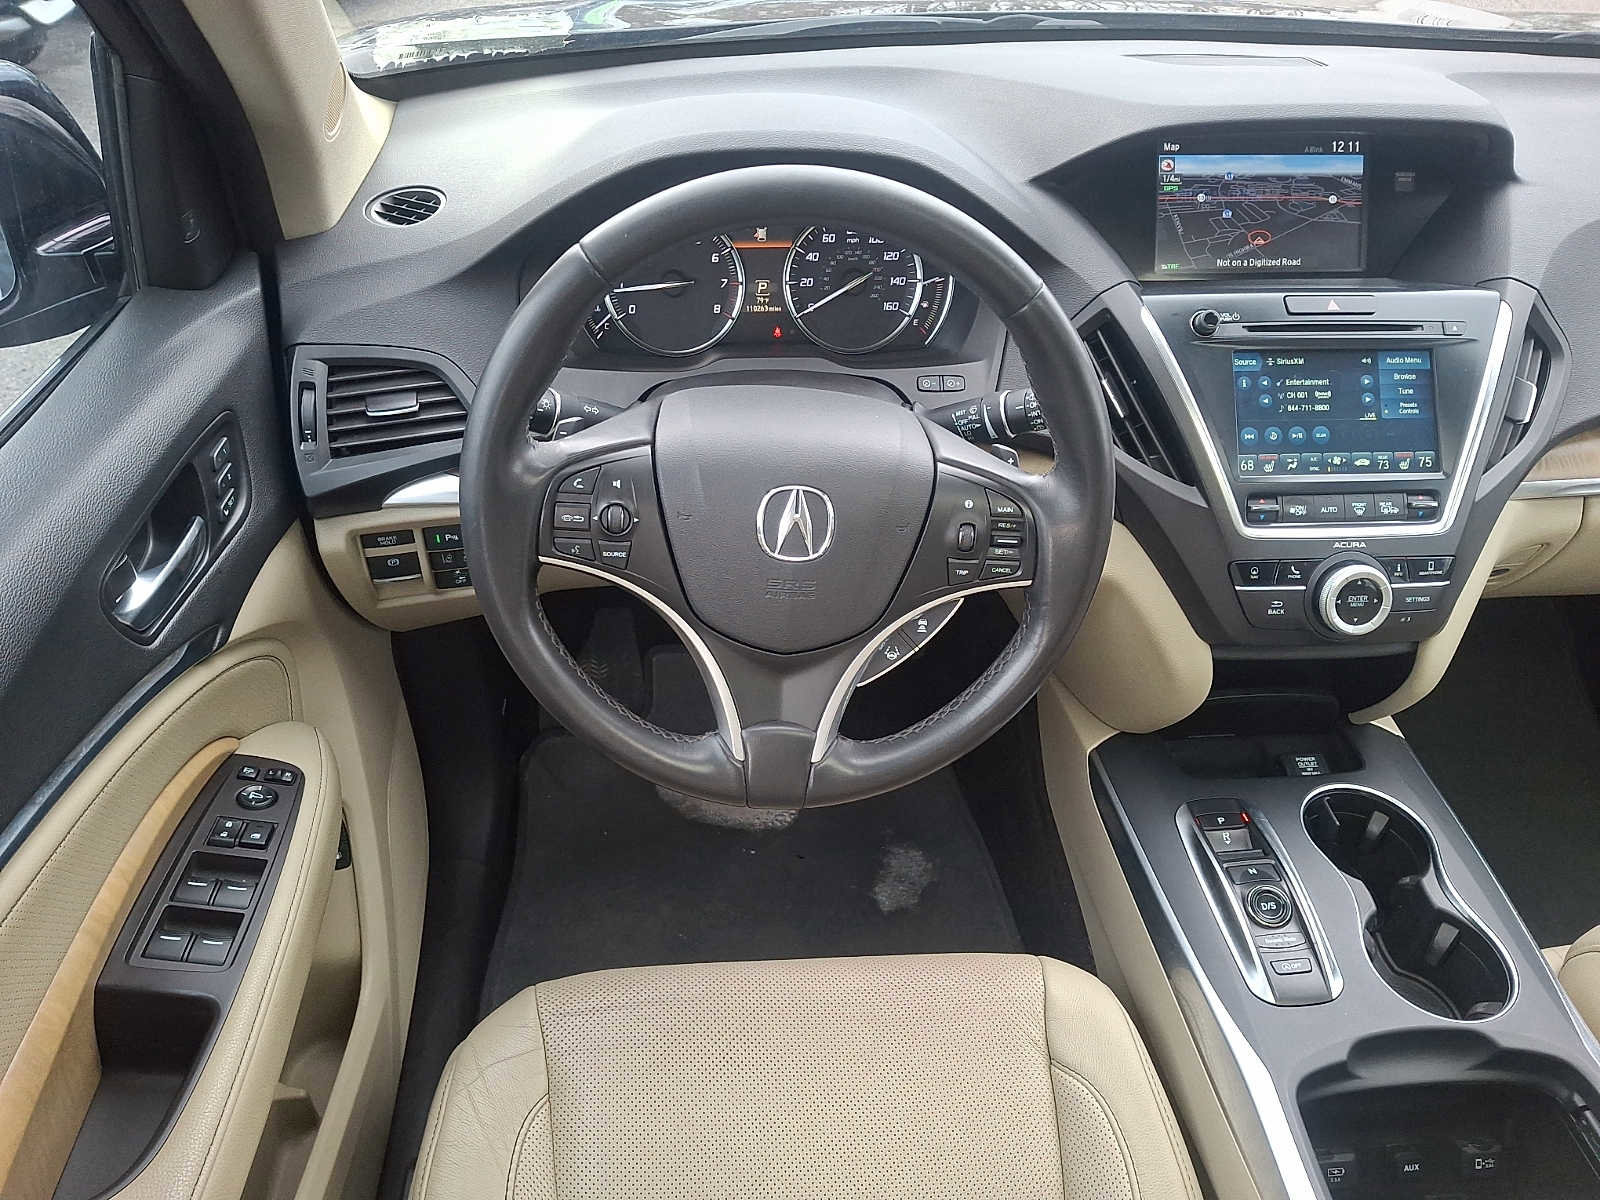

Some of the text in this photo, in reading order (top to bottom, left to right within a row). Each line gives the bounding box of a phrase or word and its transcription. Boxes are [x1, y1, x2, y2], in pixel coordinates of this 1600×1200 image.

[1163, 142, 1180, 152] Map
[822, 234, 836, 243] 60
[711, 253, 719, 263] 6
[805, 252, 820, 262] 40
[883, 251, 900, 261] 120
[1216, 259, 1230, 267] Not
[1249, 258, 1281, 268] Digitized
[1281, 258, 1301, 266] Road
[720, 279, 729, 288] 7
[800, 278, 814, 287] 20
[890, 276, 906, 286] 140
[758, 282, 768, 294] P
[628, 304, 637, 314] 0
[713, 304, 722, 314] 8
[883, 302, 900, 311] 160
[604, 322, 611, 330] C
[913, 318, 919, 326] E
[1240, 460, 1255, 471] 68
[1378, 460, 1390, 470] 73
[1419, 456, 1433, 468] 75
[1332, 541, 1367, 549] ACURA
[1217, 817, 1225, 825] P
[1223, 832, 1231, 841] R
[1260, 902, 1277, 911] D/S
[1403, 1164, 1419, 1172] AUX
